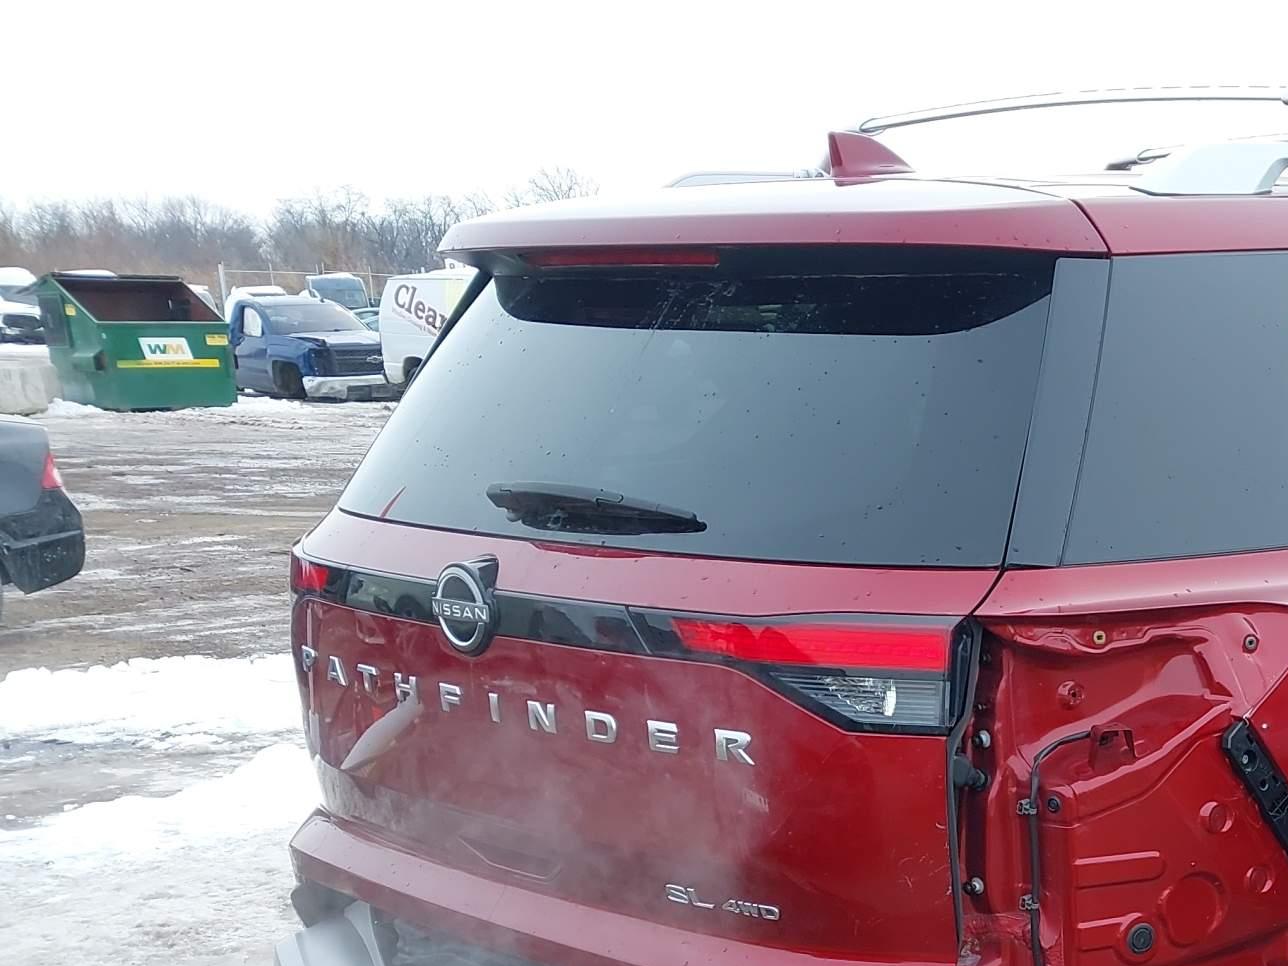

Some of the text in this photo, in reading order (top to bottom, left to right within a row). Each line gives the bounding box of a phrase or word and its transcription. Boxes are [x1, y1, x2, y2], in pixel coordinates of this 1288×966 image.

[147, 343, 186, 355] WM
[431, 600, 488, 620] NISSAN
[301, 645, 756, 766] PATHFINDER
[664, 883, 781, 921] SL 4WD
